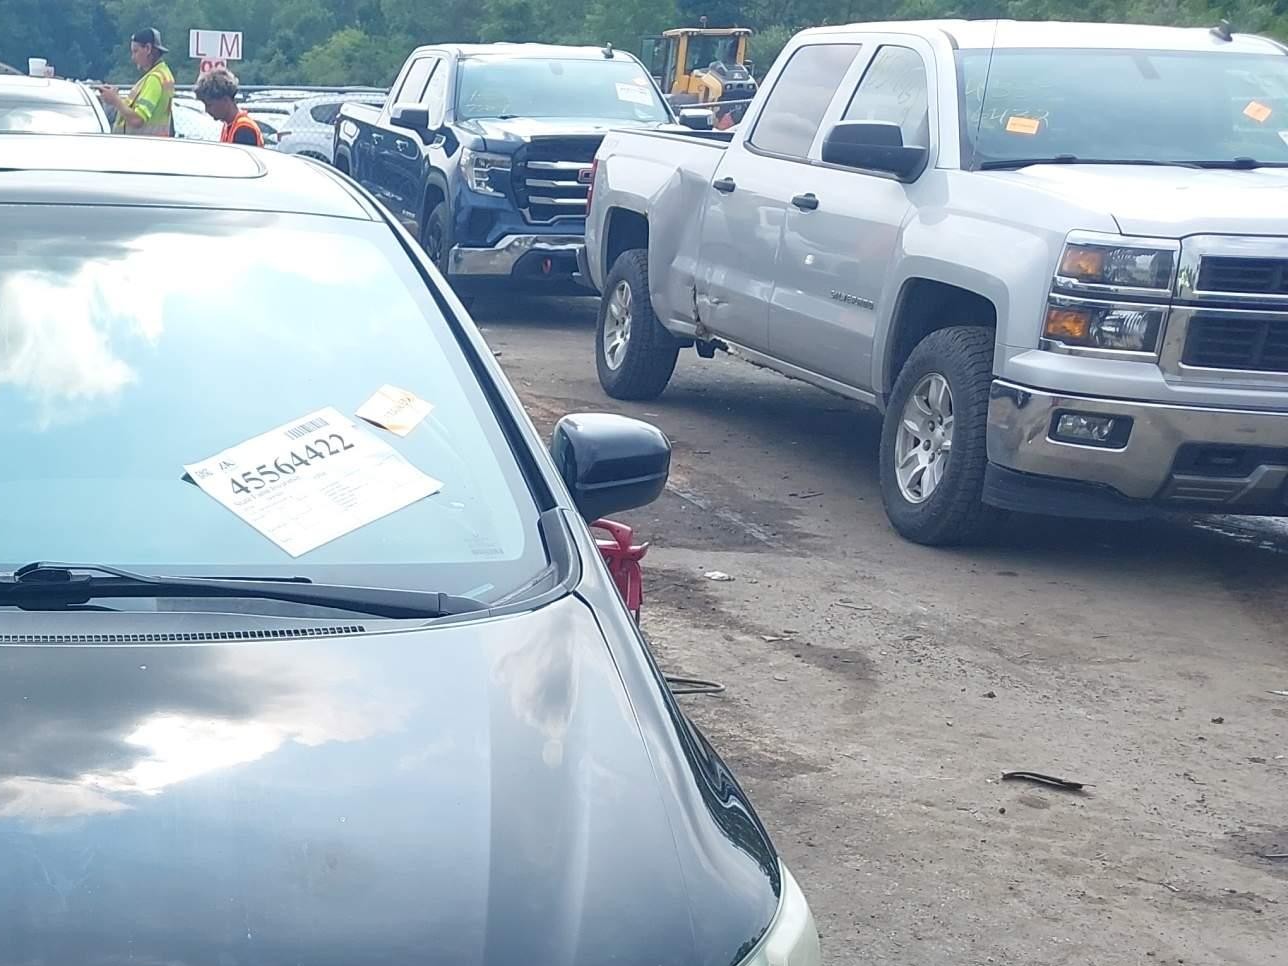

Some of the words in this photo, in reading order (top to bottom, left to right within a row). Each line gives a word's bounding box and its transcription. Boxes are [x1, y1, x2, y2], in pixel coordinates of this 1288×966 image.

[196, 32, 207, 56] L
[220, 33, 239, 58] M
[230, 433, 355, 494] 45564422
